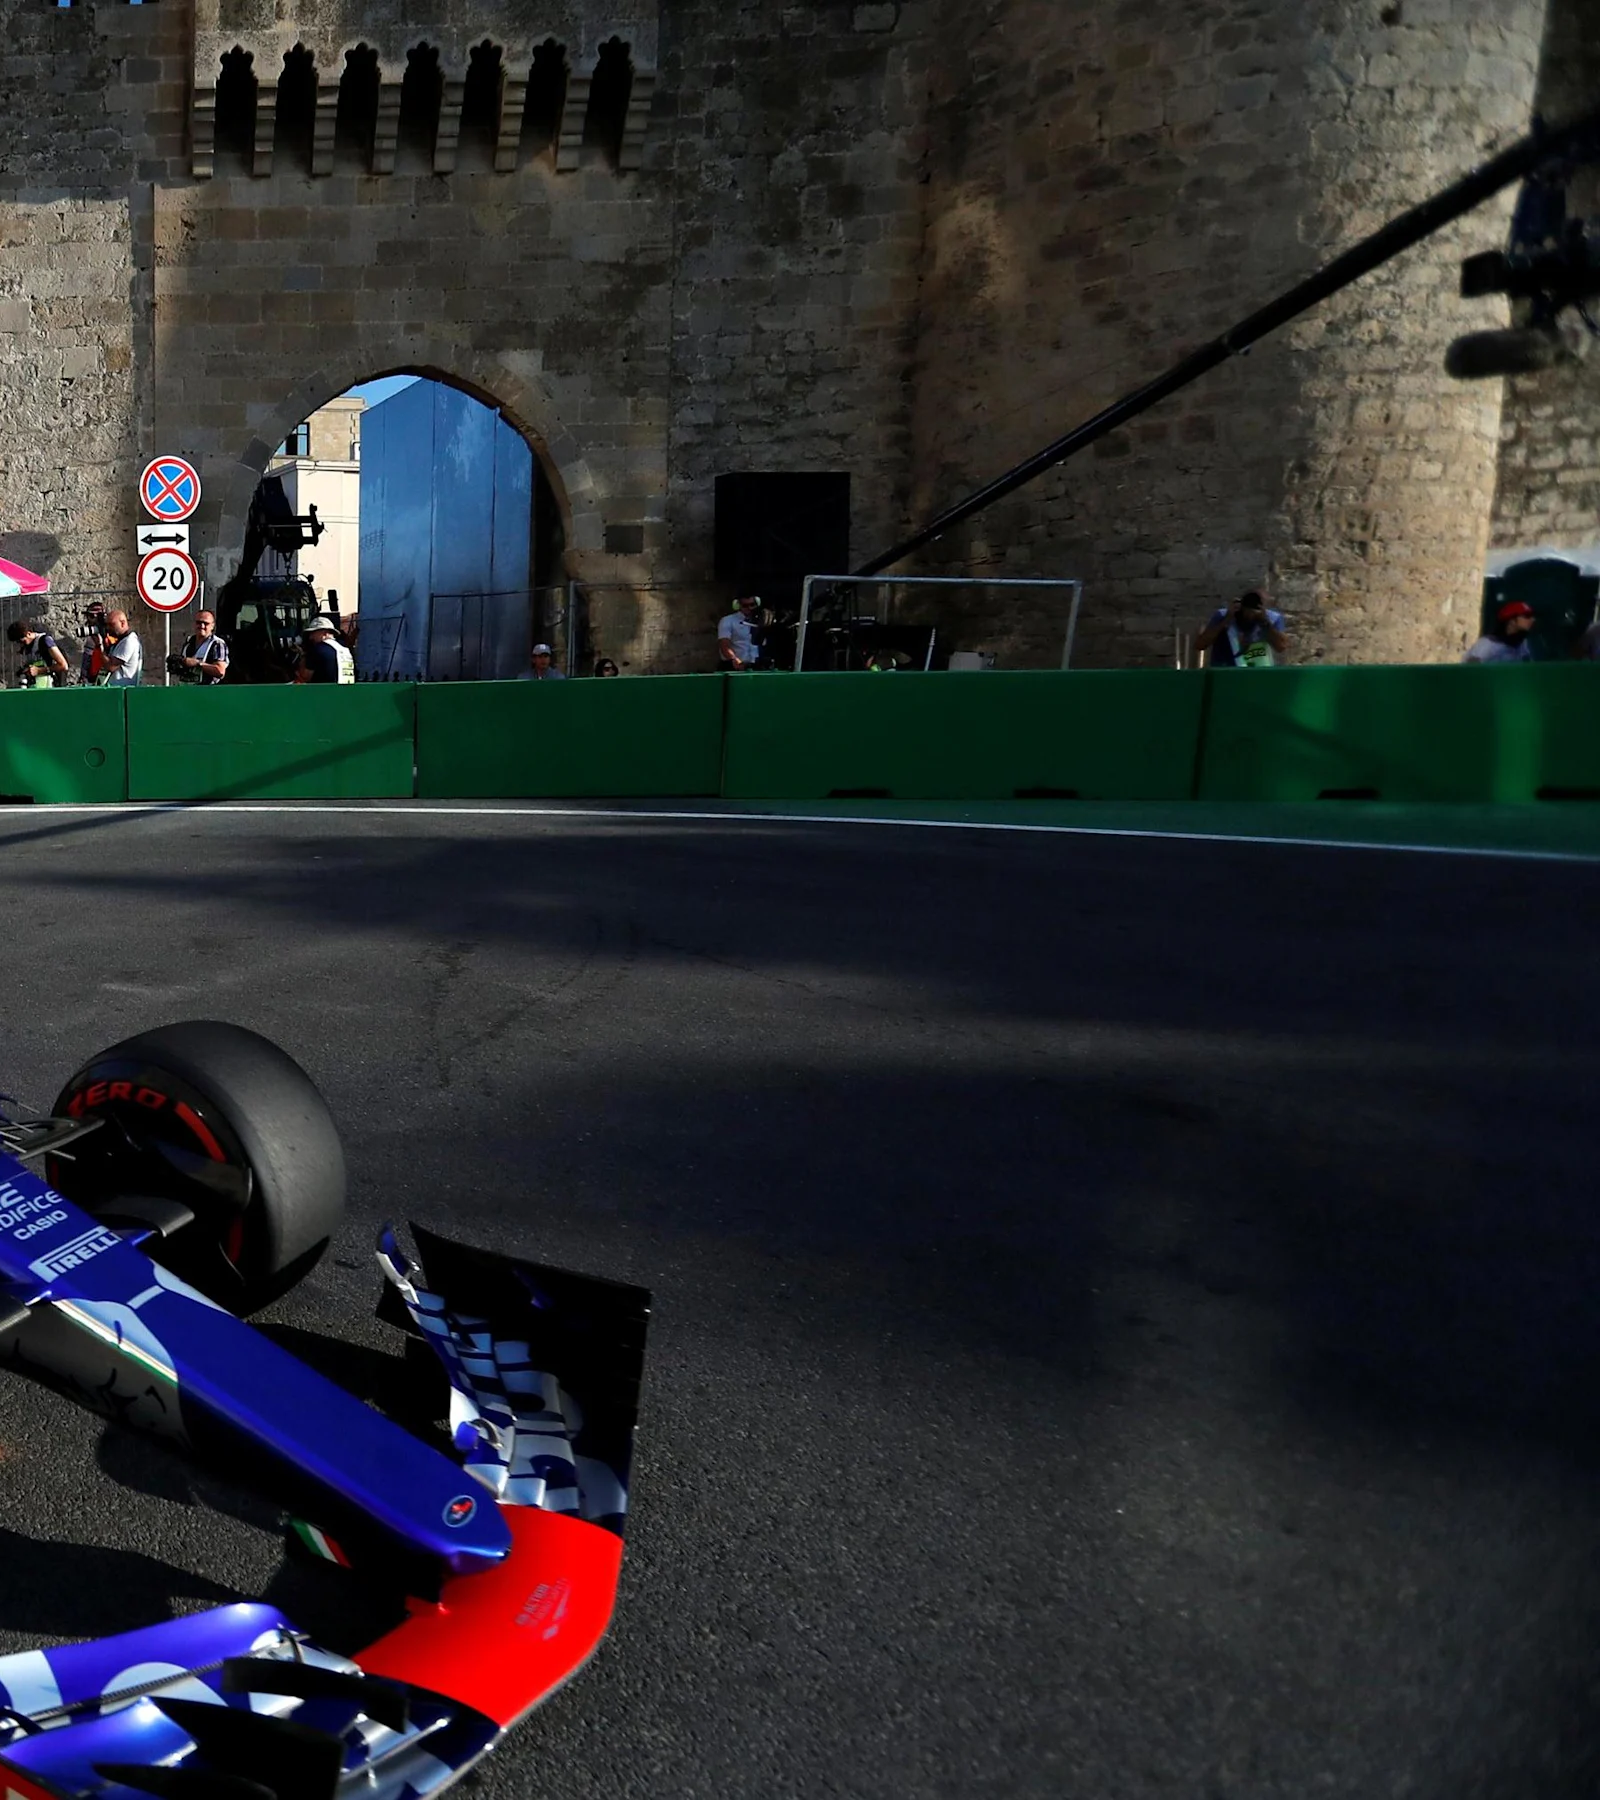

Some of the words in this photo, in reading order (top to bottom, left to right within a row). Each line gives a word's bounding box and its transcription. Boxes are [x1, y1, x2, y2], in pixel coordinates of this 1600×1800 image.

[152, 566, 185, 590] 20
[13, 1209, 69, 1241] CASIO
[28, 1225, 123, 1284] PIRELLI
